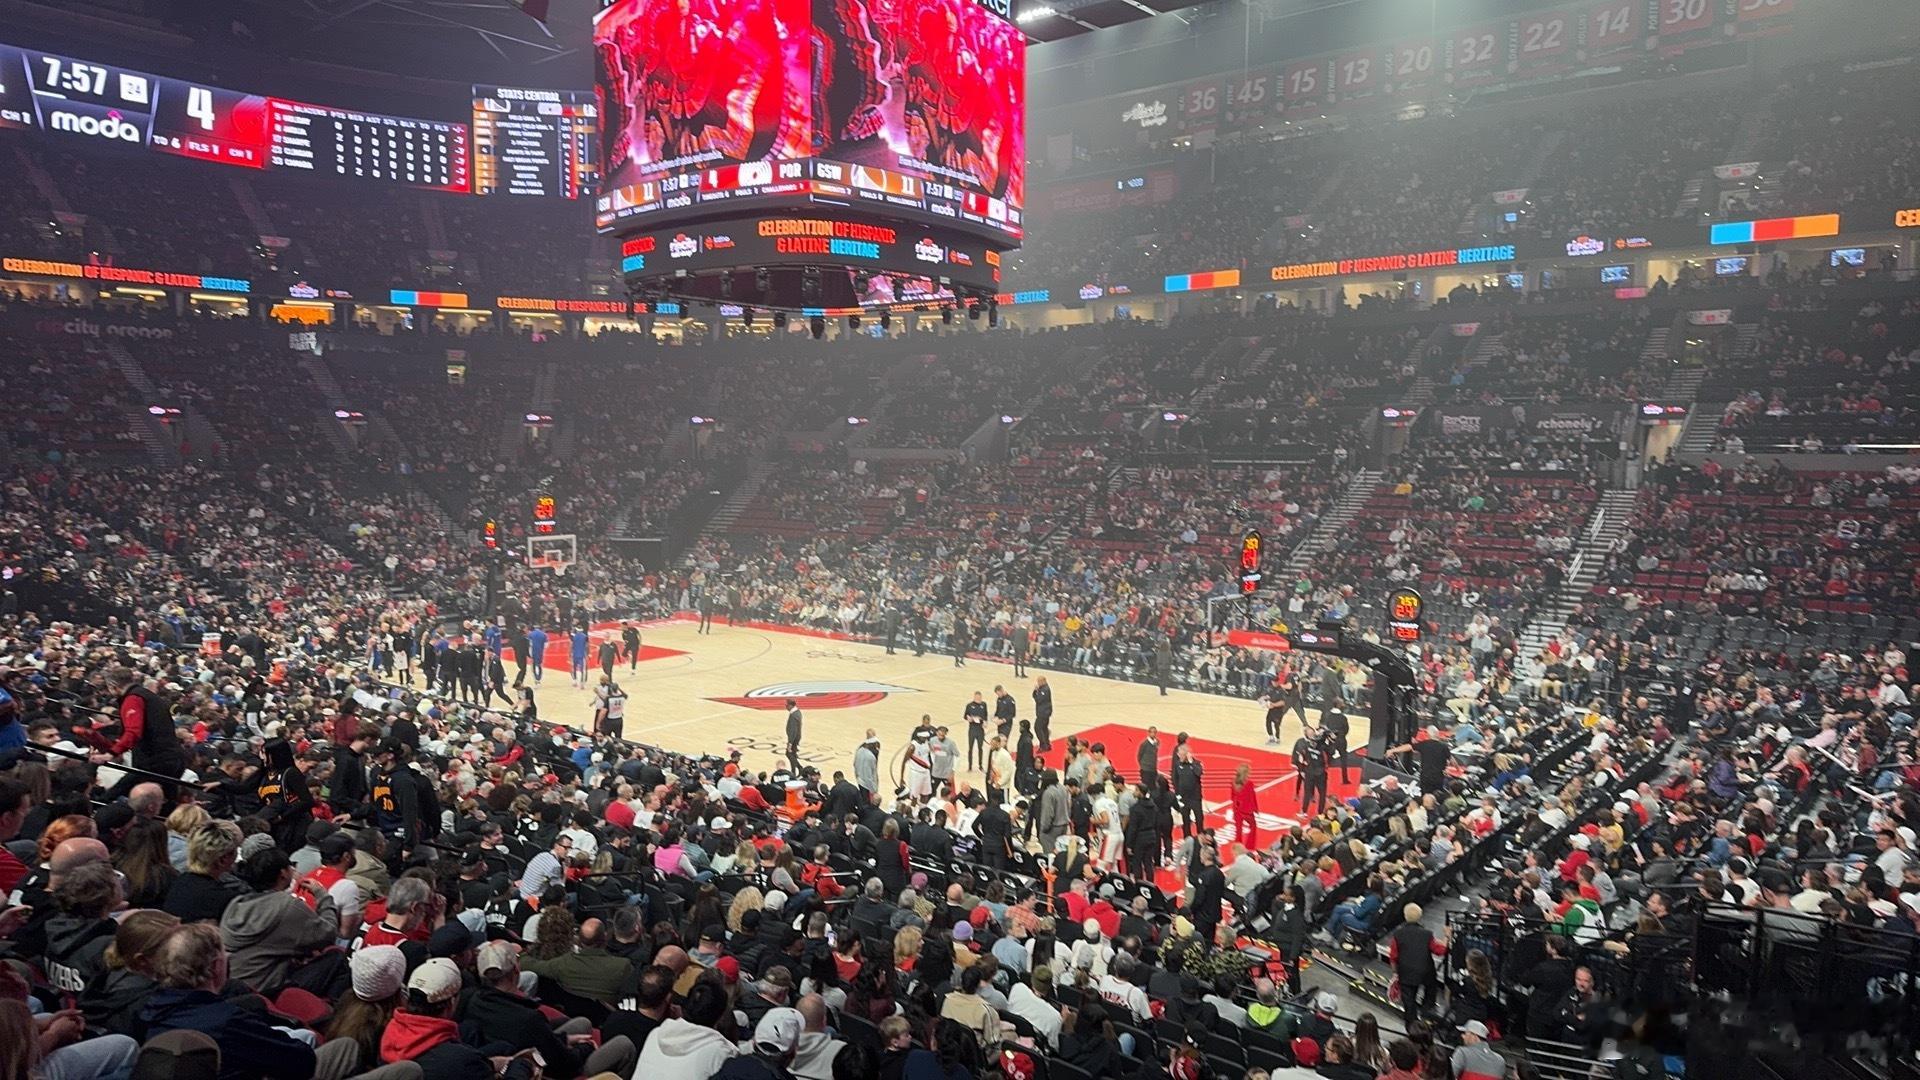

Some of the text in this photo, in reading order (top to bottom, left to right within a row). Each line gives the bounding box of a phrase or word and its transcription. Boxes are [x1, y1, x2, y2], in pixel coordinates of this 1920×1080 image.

[1597, 6, 1631, 38] 14
[1523, 20, 1564, 53] 22
[1398, 46, 1433, 76] 20
[1460, 34, 1495, 65] 32
[43, 56, 107, 96] 7:57
[1290, 68, 1318, 94] 15
[1343, 58, 1370, 85] 13
[497, 88, 561, 102] STATS CENTRAL
[1189, 87, 1217, 114] 36
[1237, 77, 1267, 104] 45
[187, 87, 215, 130] 4
[51, 111, 140, 143] moda
[709, 170, 718, 188] 4
[779, 163, 801, 179] POR
[817, 163, 842, 180] GSW
[643, 183, 655, 201] 11
[662, 176, 679, 193] 7:57
[901, 175, 916, 196] 11
[926, 181, 943, 197] 7:57
[758, 219, 896, 244] CELEBRATION OF HISPANIC
[777, 237, 880, 259] & LATINE HERITAGE
[3, 257, 250, 292] CELEBRATION OF HISPANIC & LATINE HERITAGE
[1272, 245, 1515, 281] CELEBRATION OF HISPANIC & LATINE HERITAGE
[497, 297, 556, 311] CELEBRATION
[556, 300, 569, 312] OF
[1014, 290, 1050, 305] HERITAGE
[1395, 604, 1414, 618] 24
